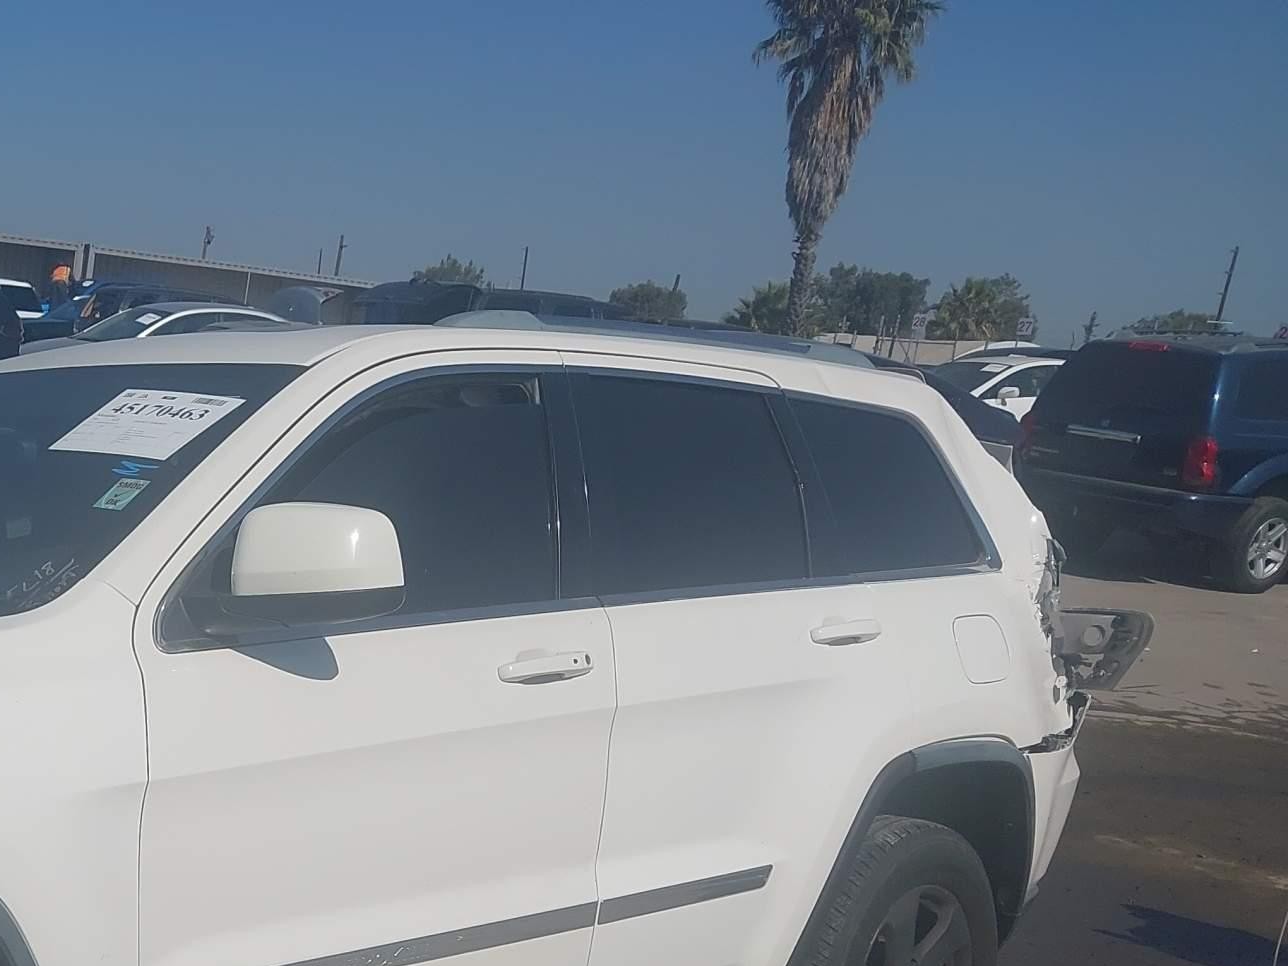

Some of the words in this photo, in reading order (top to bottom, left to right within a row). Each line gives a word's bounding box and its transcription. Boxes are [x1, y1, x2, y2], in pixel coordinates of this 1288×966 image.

[1017, 321, 1032, 333] 27
[112, 402, 210, 421] 45170463
[117, 481, 145, 490] SMOG
